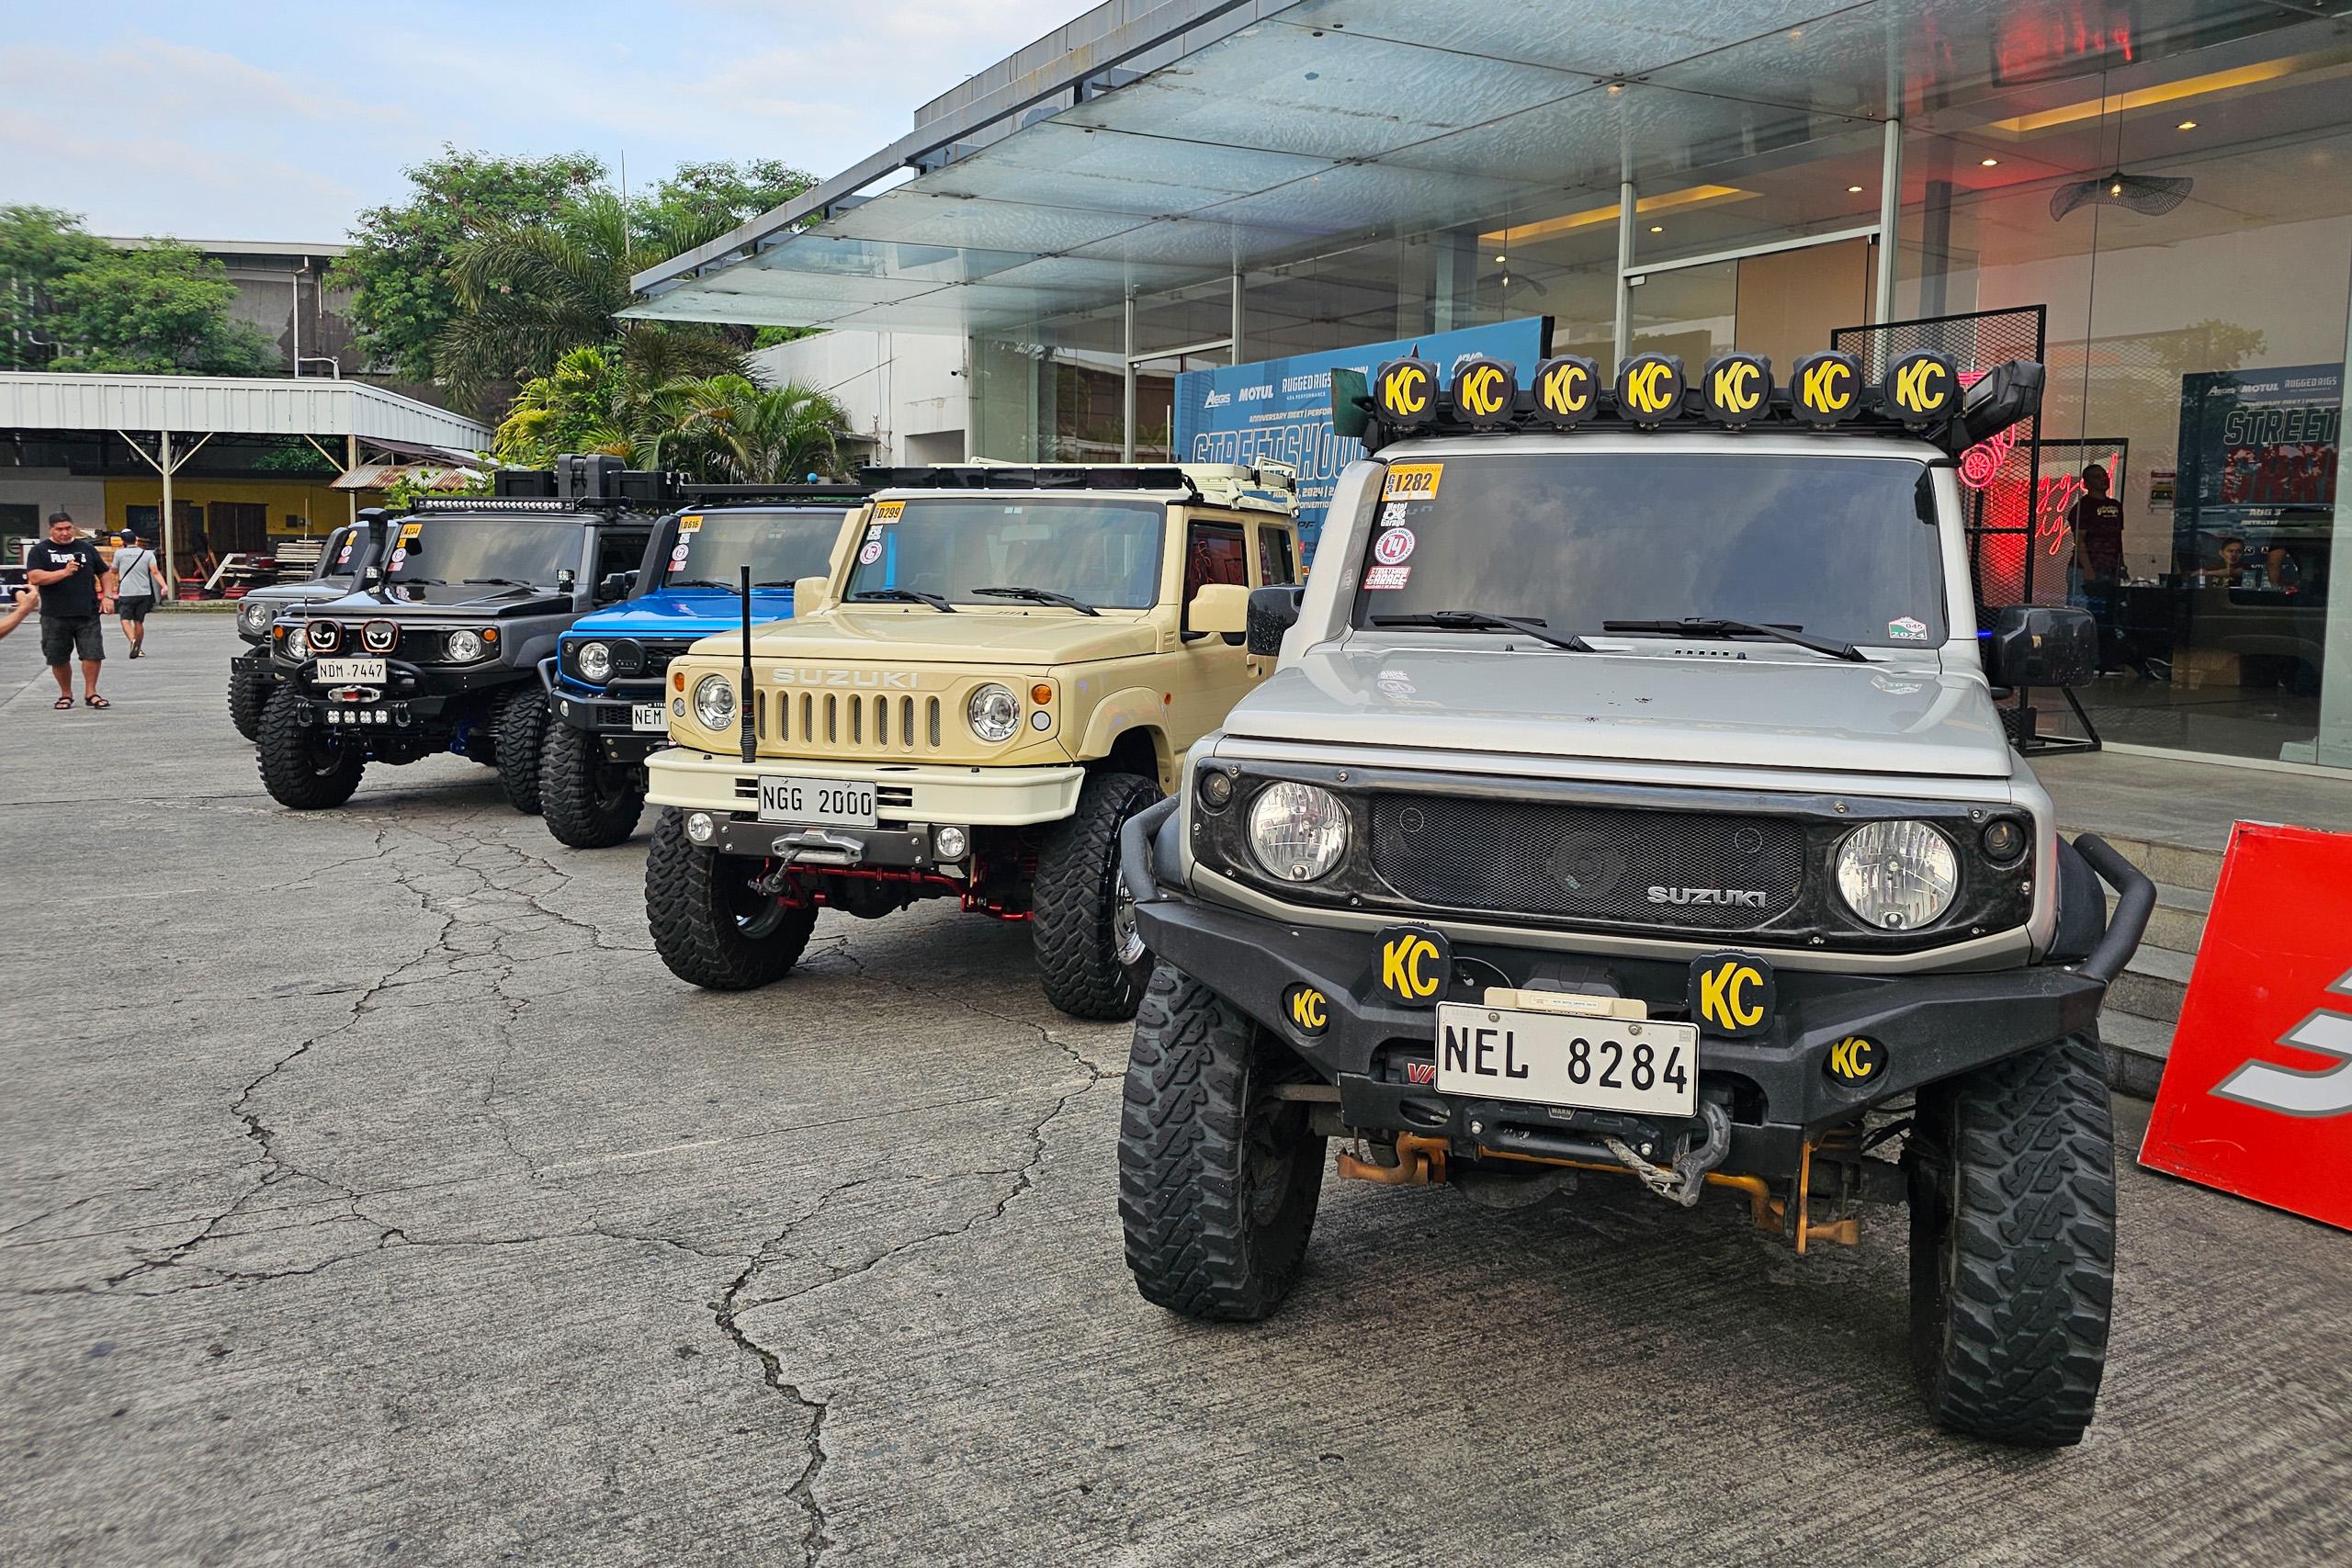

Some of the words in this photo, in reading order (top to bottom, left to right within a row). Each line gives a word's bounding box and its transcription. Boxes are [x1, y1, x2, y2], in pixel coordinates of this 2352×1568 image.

[1238, 384, 1274, 402] MOTUL
[1385, 367, 1426, 415] KC
[1463, 366, 1504, 415] KC
[1544, 365, 1587, 414] KC
[1628, 362, 1672, 412] KC
[1715, 361, 1759, 412] KC
[1804, 361, 1849, 412] KC
[1896, 359, 1945, 412] KC
[2241, 382, 2278, 393] MOTUL
[1250, 412, 1287, 423] ANNIVERSARY
[1287, 411, 1305, 420] MEET
[2223, 406, 2341, 446] STREET
[1302, 487, 1324, 497] 2024
[1395, 473, 1433, 492] 1282
[1299, 501, 1330, 509] ONVENTIO
[2248, 508, 2272, 516] AUG
[1365, 574, 1408, 586] GARAGE
[320, 664, 344, 678] NDM
[352, 664, 382, 678] 7447
[772, 668, 918, 689] SUZUKI
[635, 709, 662, 725] NEM
[763, 785, 802, 812] NGG
[819, 790, 872, 817] 2000
[1647, 886, 1767, 908] SUZUKI
[1383, 934, 1441, 999] KC
[1293, 988, 1328, 1028] KC
[1700, 962, 1765, 1031] KC
[1445, 1025, 1529, 1079] NEL
[1567, 1037, 1688, 1094] 8284
[1831, 1036, 1872, 1078] KC
[1551, 1108, 1572, 1116] WARN
